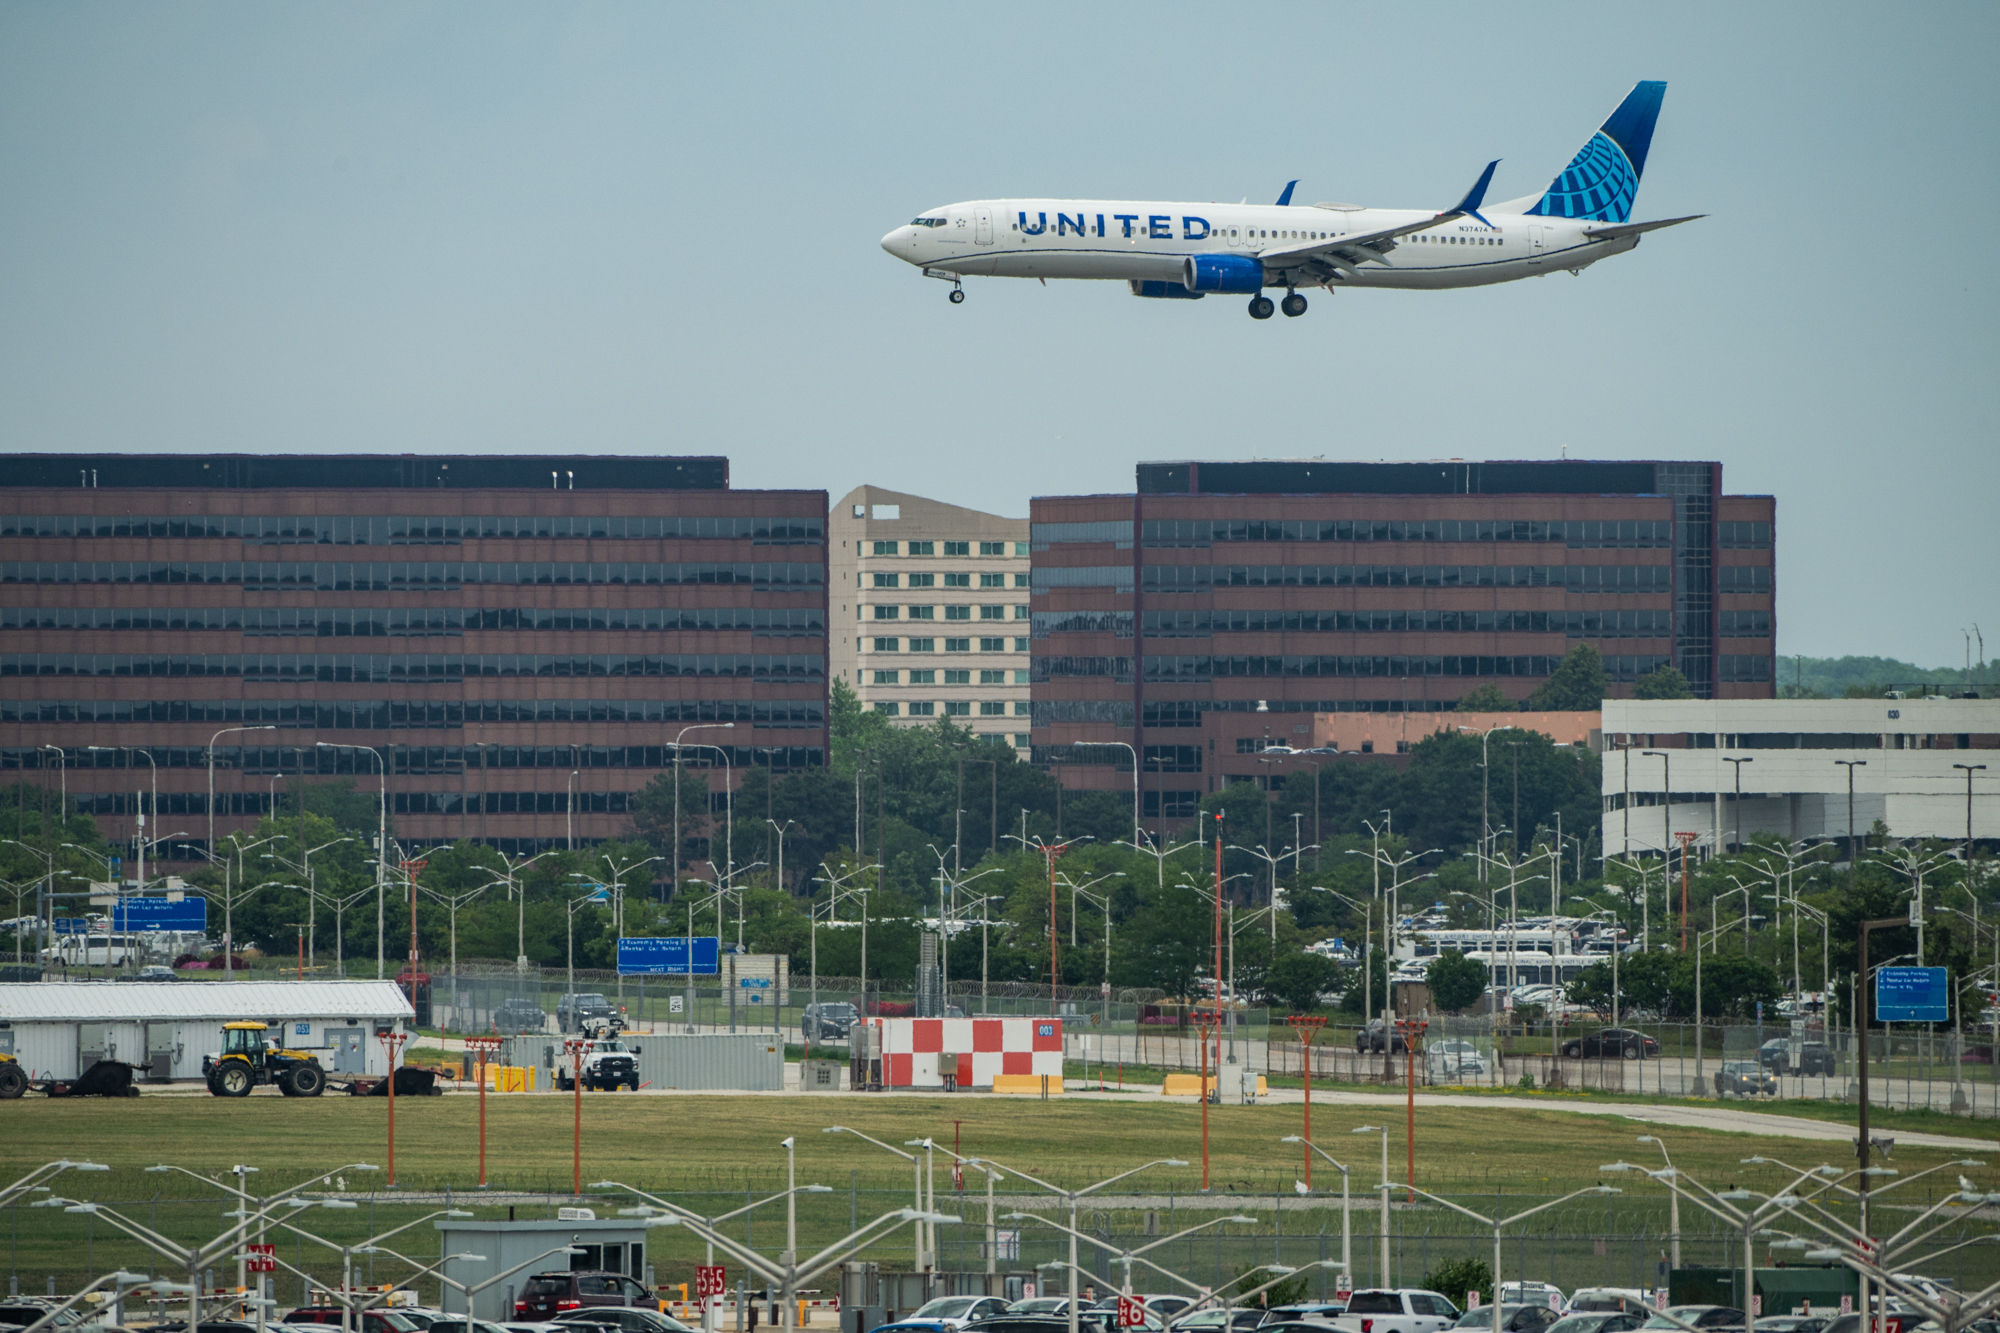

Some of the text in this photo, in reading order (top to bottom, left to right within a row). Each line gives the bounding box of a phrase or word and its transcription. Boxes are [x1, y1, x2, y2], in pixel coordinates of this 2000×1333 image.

[1018, 212, 1210, 240] UNITED
[1888, 710, 1899, 719] 830
[297, 1025, 309, 1033] 053
[1040, 1026, 1053, 1035] 003
[702, 1270, 707, 1291] 5
[716, 1270, 723, 1291] 5
[1130, 1300, 1142, 1323] 6
